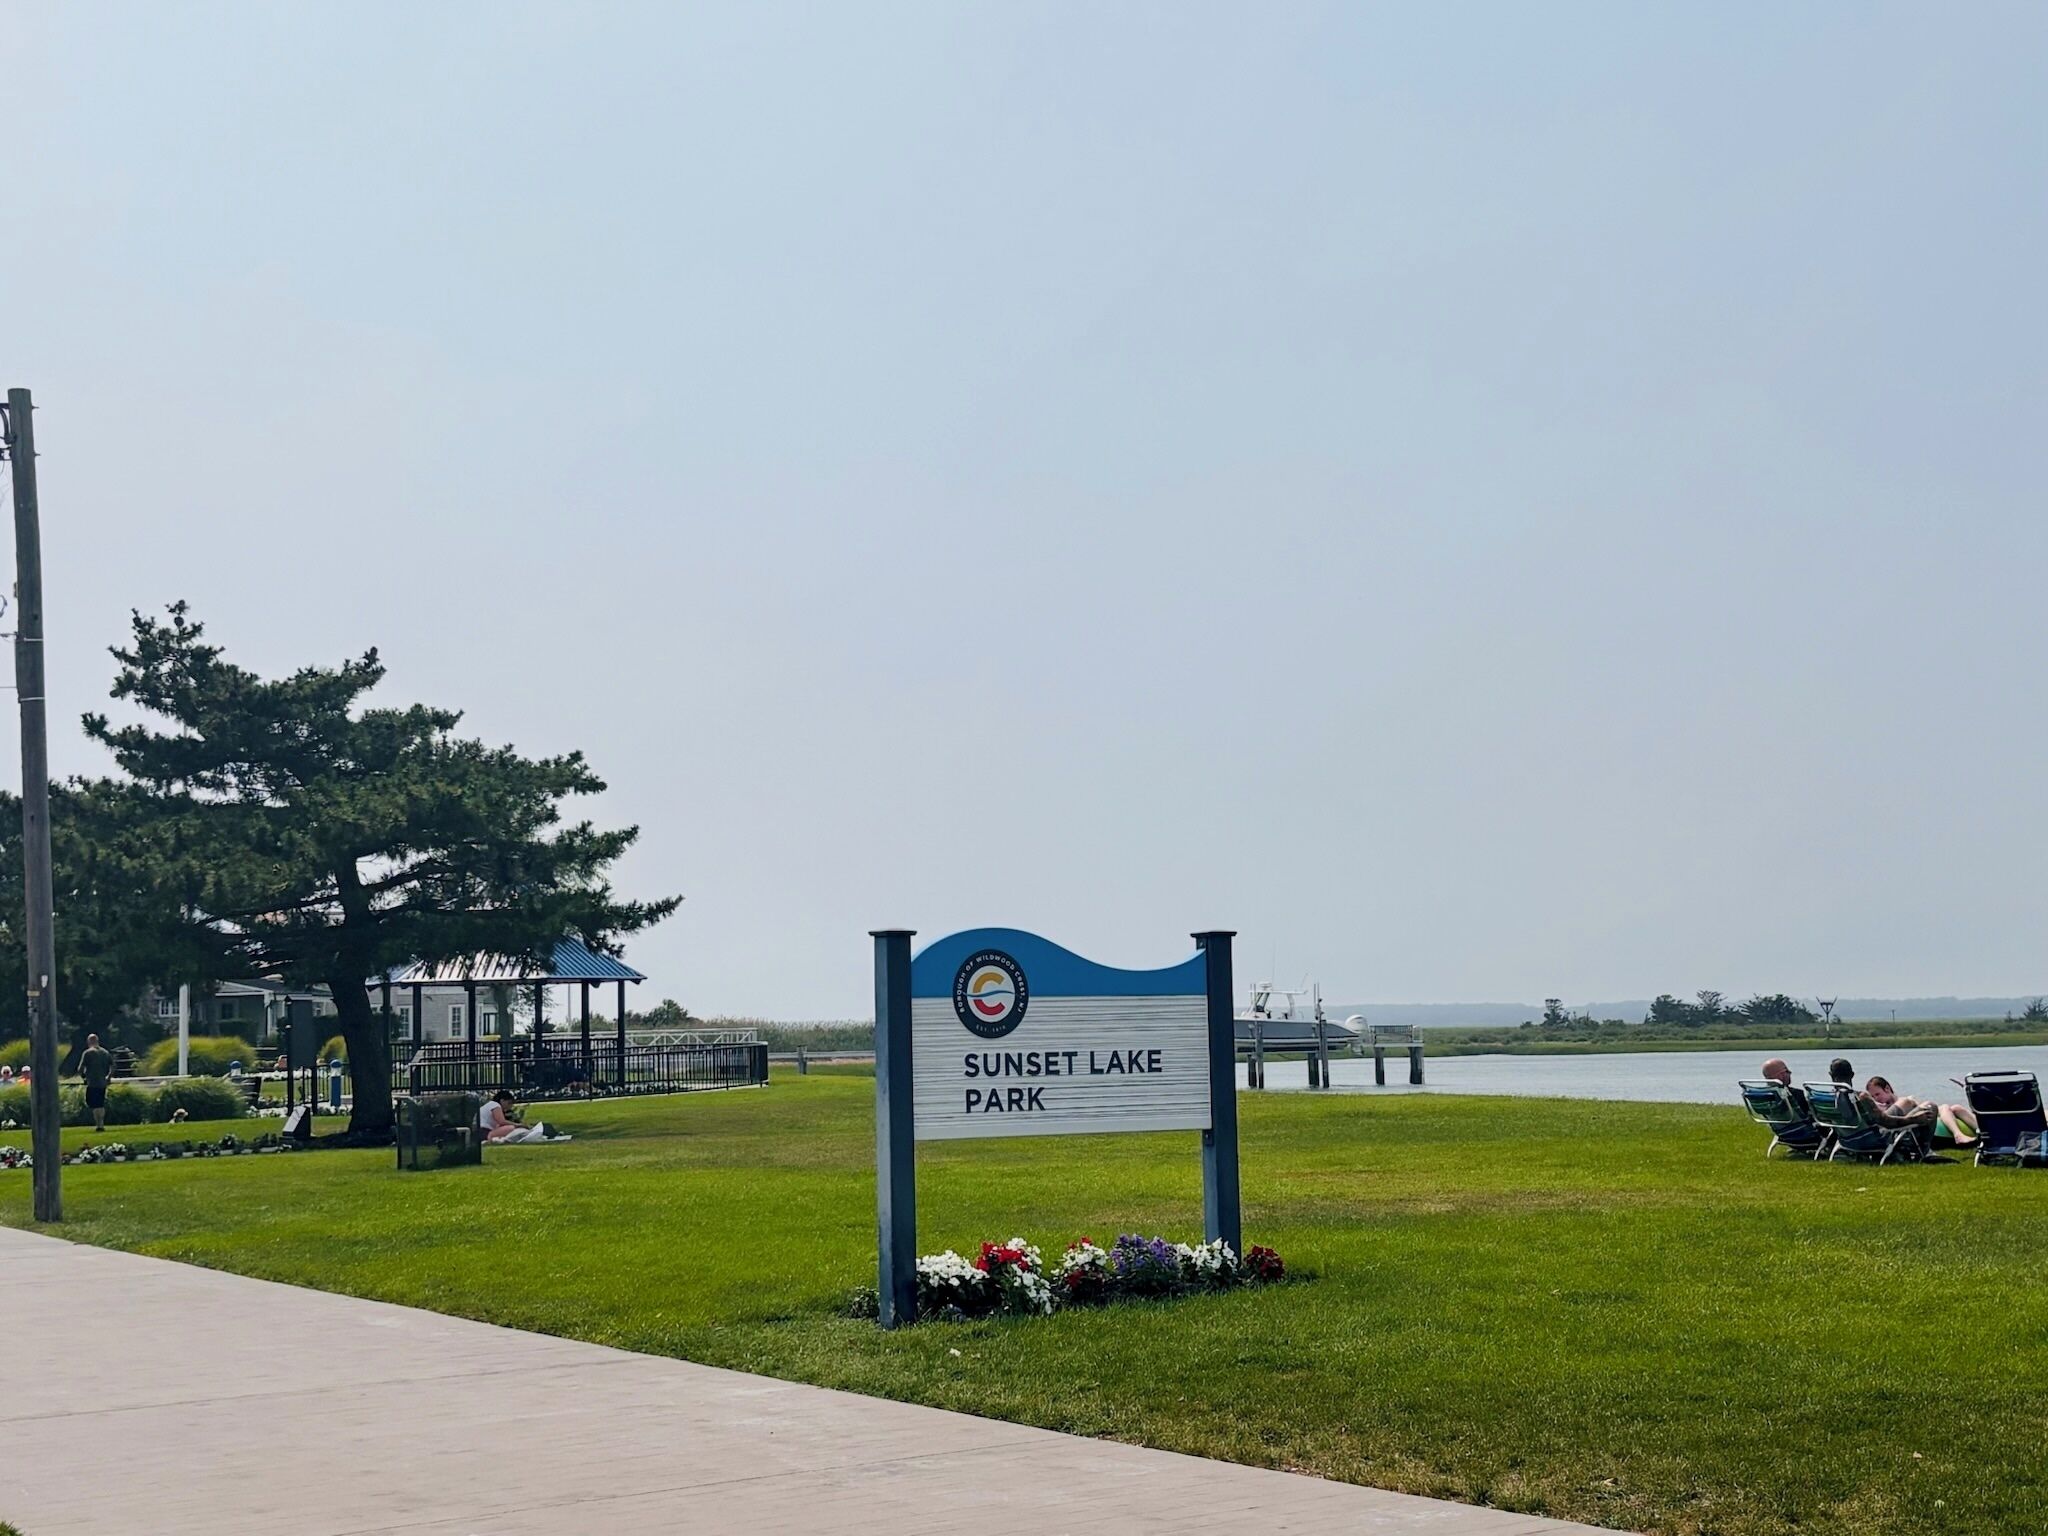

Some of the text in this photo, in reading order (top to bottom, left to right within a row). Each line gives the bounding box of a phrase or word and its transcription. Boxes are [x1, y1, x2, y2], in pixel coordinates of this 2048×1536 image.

[965, 961, 975, 972] OF
[975, 954, 1015, 971] WILDWOOD
[964, 1050, 1163, 1077] SUNSET LAKE
[965, 1087, 1046, 1113] PARK
